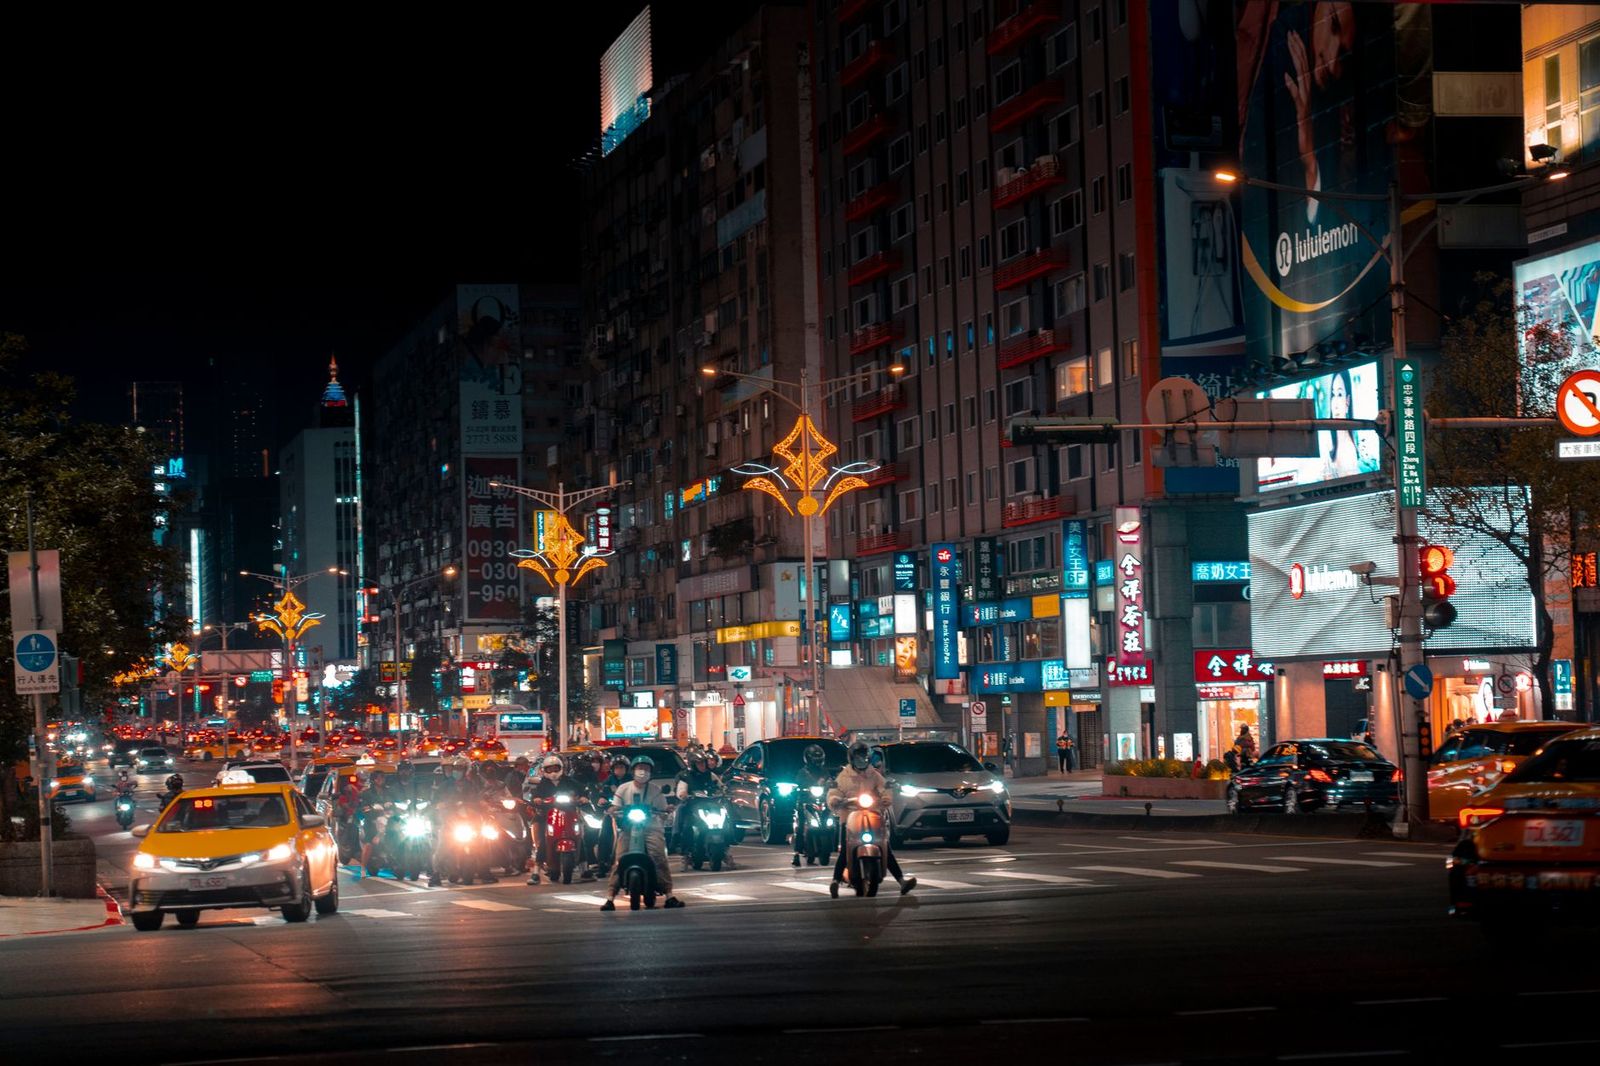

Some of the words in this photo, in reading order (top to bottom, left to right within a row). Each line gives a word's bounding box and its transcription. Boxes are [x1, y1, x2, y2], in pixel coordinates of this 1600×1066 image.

[1295, 222, 1358, 264] lululemon
[1403, 384, 1416, 454] 忠孝東路四段
[468, 504, 517, 528] 廣告
[468, 540, 517, 558] 0930
[469, 562, 518, 580] -030
[1068, 572, 1083, 583] 6F
[469, 585, 518, 602] -950
[939, 566, 951, 614] 永豐銀行
[1119, 553, 1142, 653] 全祥茶莊
[17, 674, 58, 684] 行人優先
[901, 700, 908, 710] P
